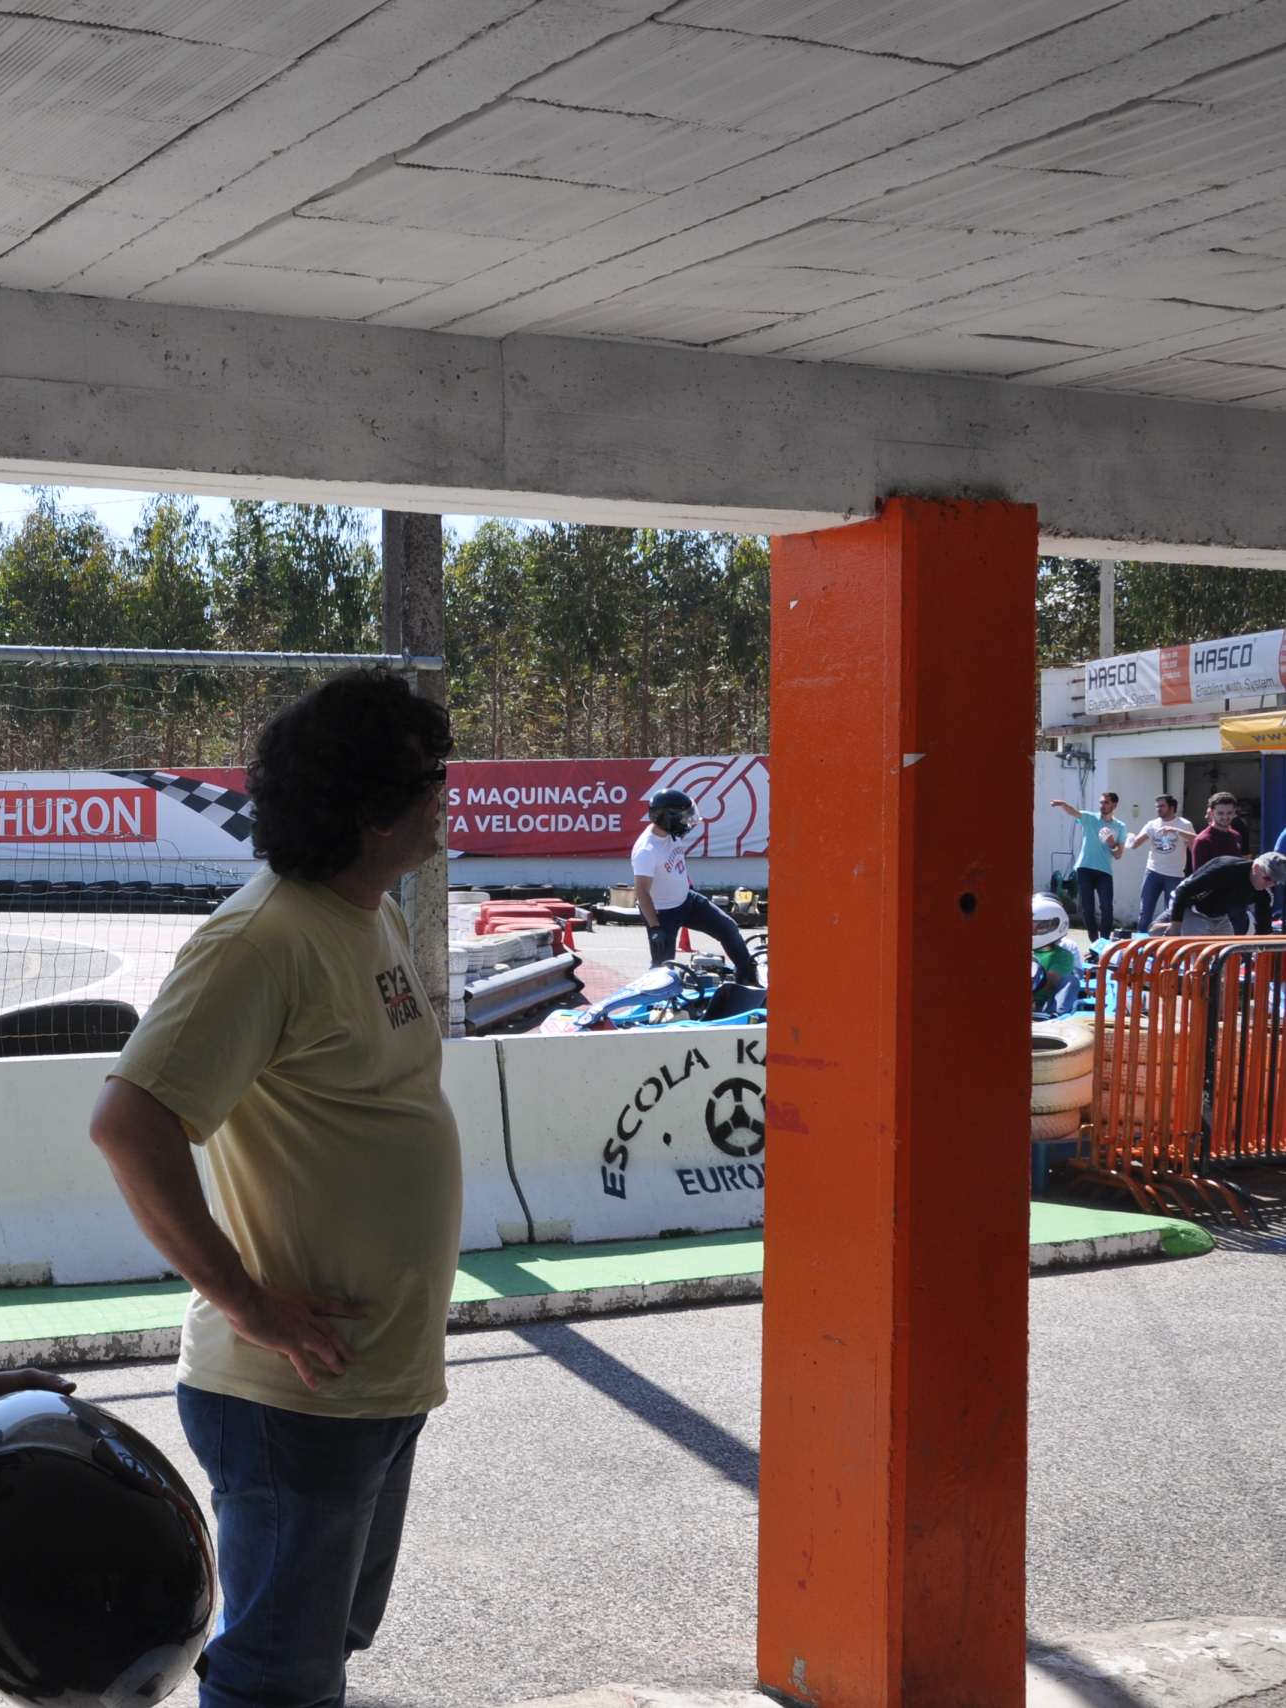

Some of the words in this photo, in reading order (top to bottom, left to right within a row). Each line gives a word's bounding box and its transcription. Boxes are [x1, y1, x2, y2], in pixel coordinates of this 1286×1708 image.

[1194, 643, 1253, 674] HASCO
[1089, 662, 1137, 690] HASCO
[448, 788, 461, 806] S
[467, 782, 627, 808] MAQUINAÇÃO
[474, 814, 622, 833] VELOCIDADE
[601, 1048, 710, 1200] ESCOLA
[737, 1038, 766, 1066] K
[675, 1163, 765, 1196] EURO
